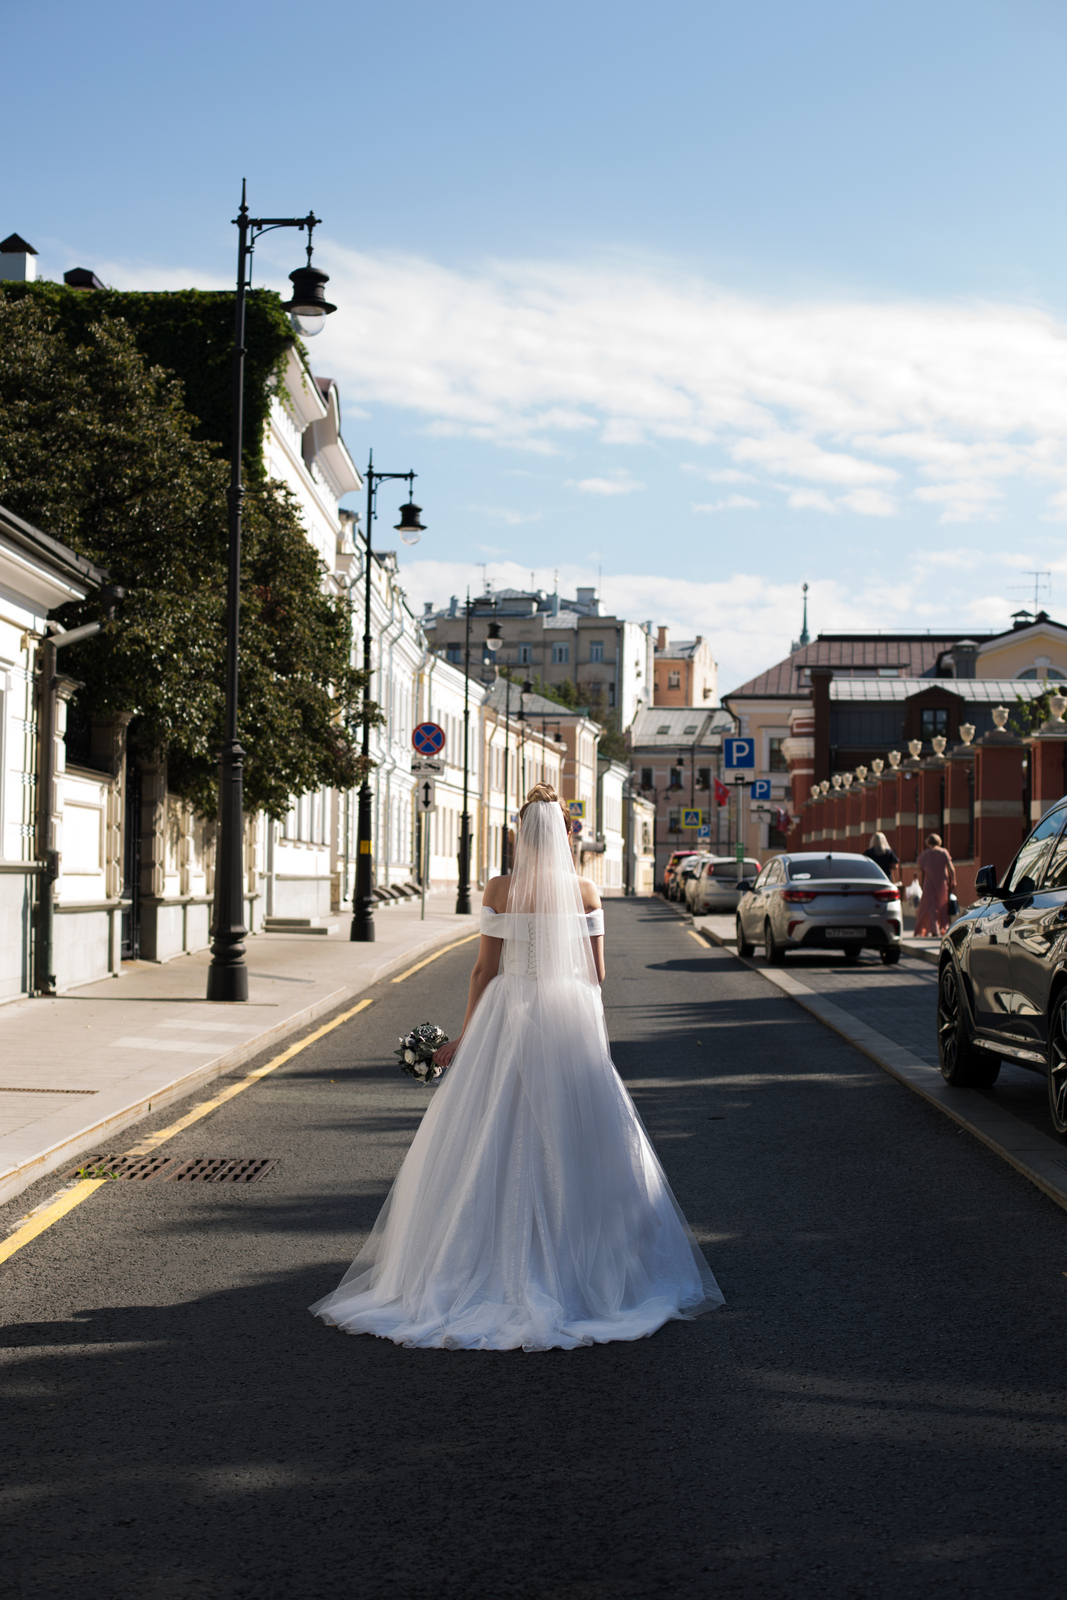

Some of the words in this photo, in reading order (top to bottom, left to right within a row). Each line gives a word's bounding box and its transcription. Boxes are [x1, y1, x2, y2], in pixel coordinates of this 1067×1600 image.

[732, 741, 750, 766] P
[756, 781, 768, 798] P
[700, 825, 708, 836] P
